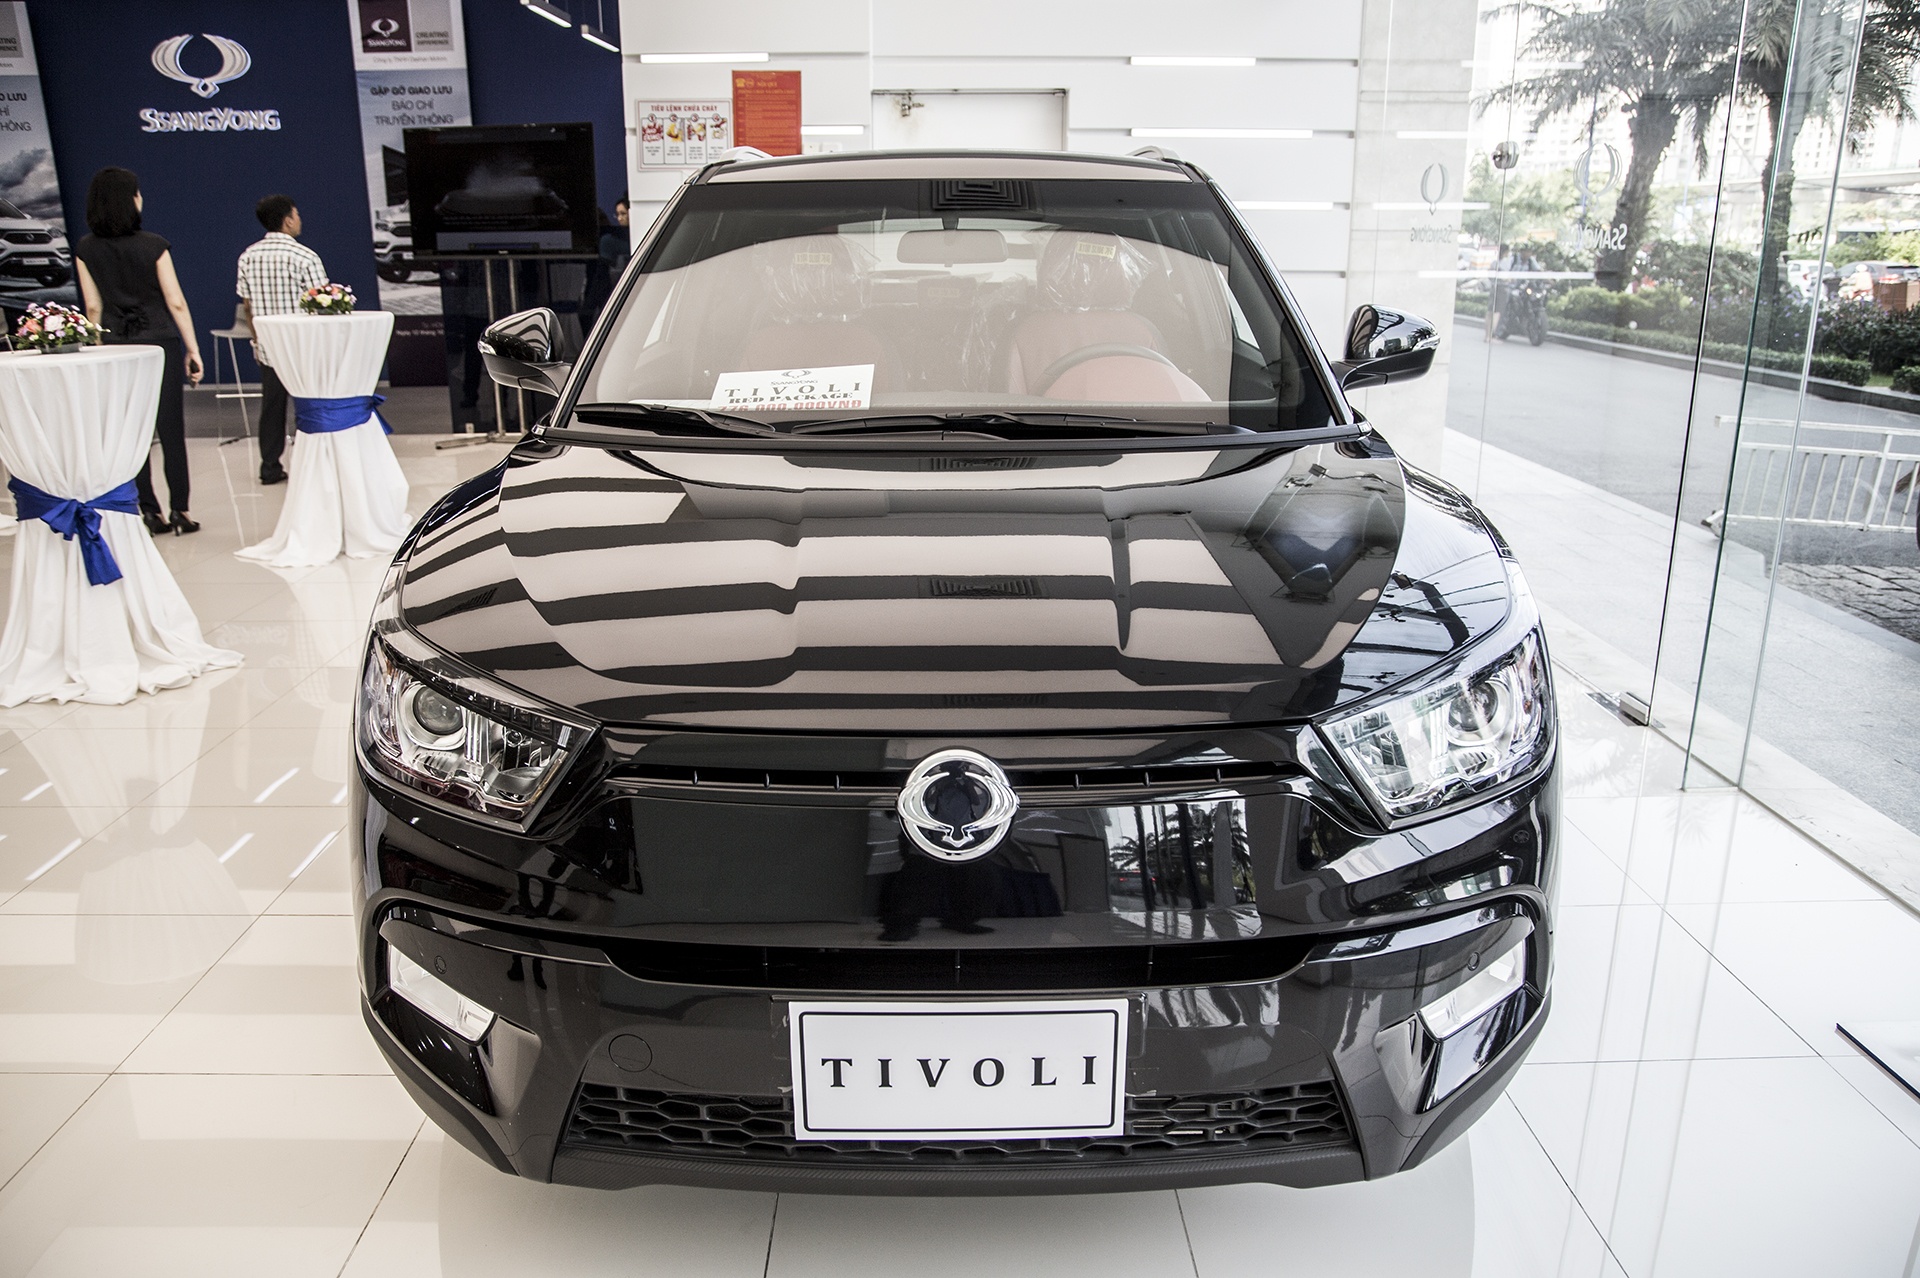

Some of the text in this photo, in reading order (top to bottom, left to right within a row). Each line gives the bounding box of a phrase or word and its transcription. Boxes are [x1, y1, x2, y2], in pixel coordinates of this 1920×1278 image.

[7, 92, 28, 101] LƯU
[408, 86, 431, 96] GIAO
[417, 112, 454, 125] THÔNG
[725, 382, 862, 398] TIVOLI
[769, 392, 853, 402] PACKAGE
[820, 1055, 1098, 1088] TIVOLI
